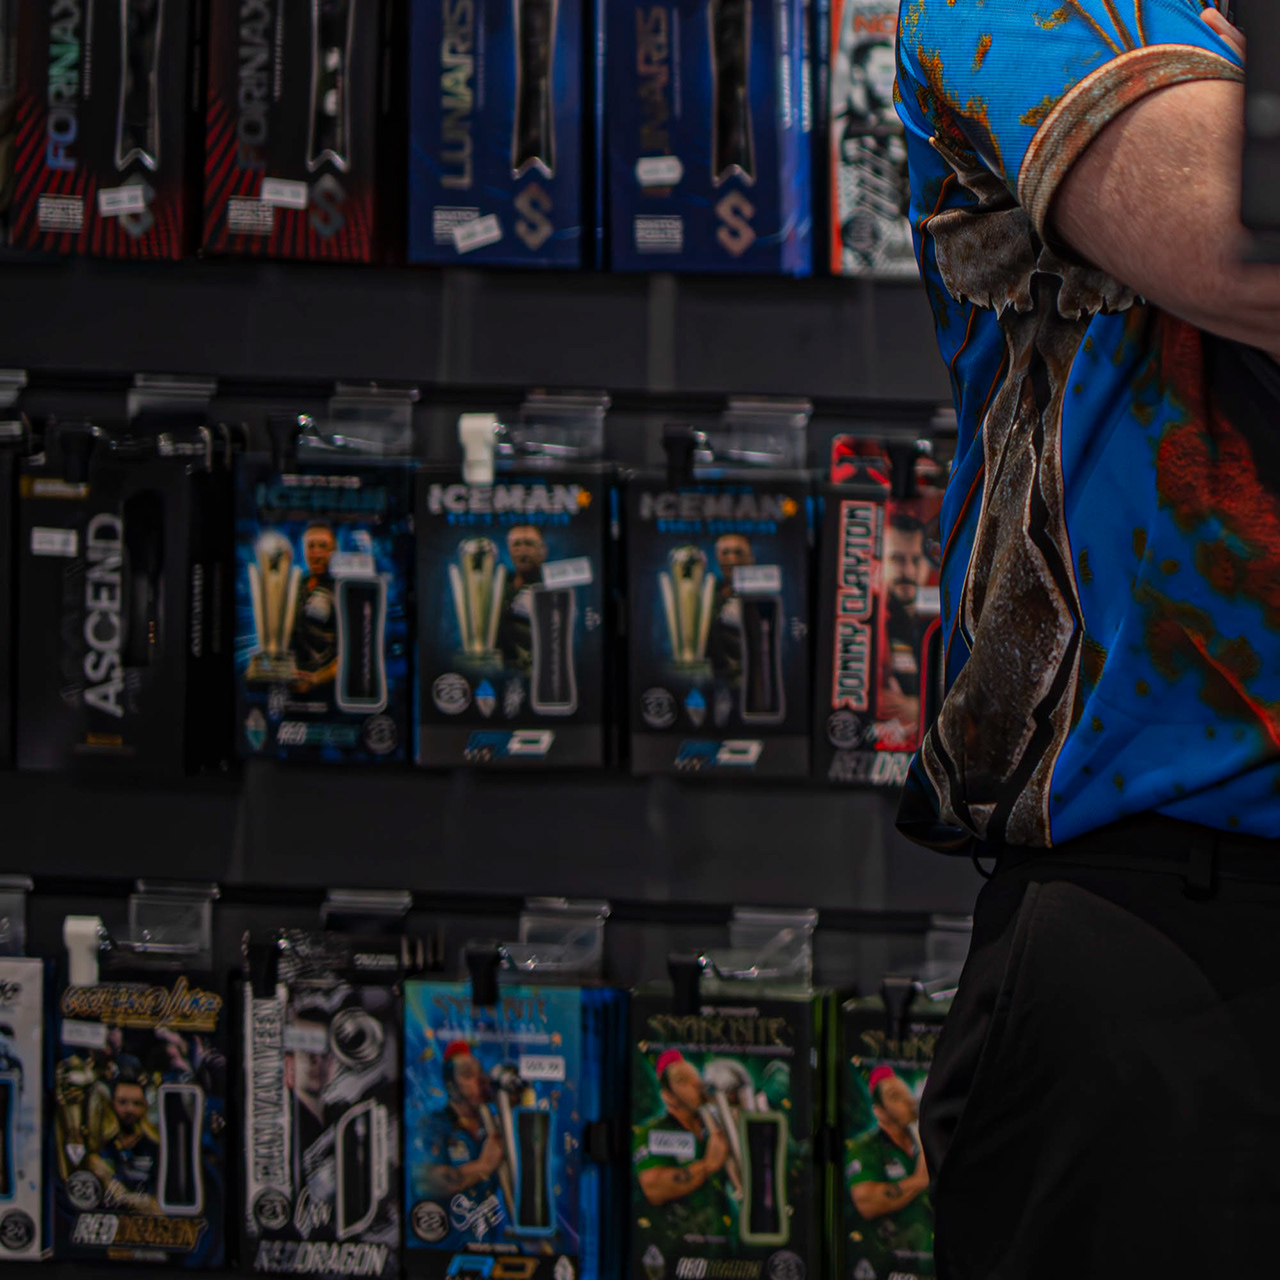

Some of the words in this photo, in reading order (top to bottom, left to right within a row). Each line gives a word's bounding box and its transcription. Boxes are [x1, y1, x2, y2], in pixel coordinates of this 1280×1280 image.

[634, 5, 670, 197] UNARIS
[427, 482, 582, 516] ICEMAN
[639, 489, 786, 521] ICEMAN
[83, 511, 126, 720] ASCEND
